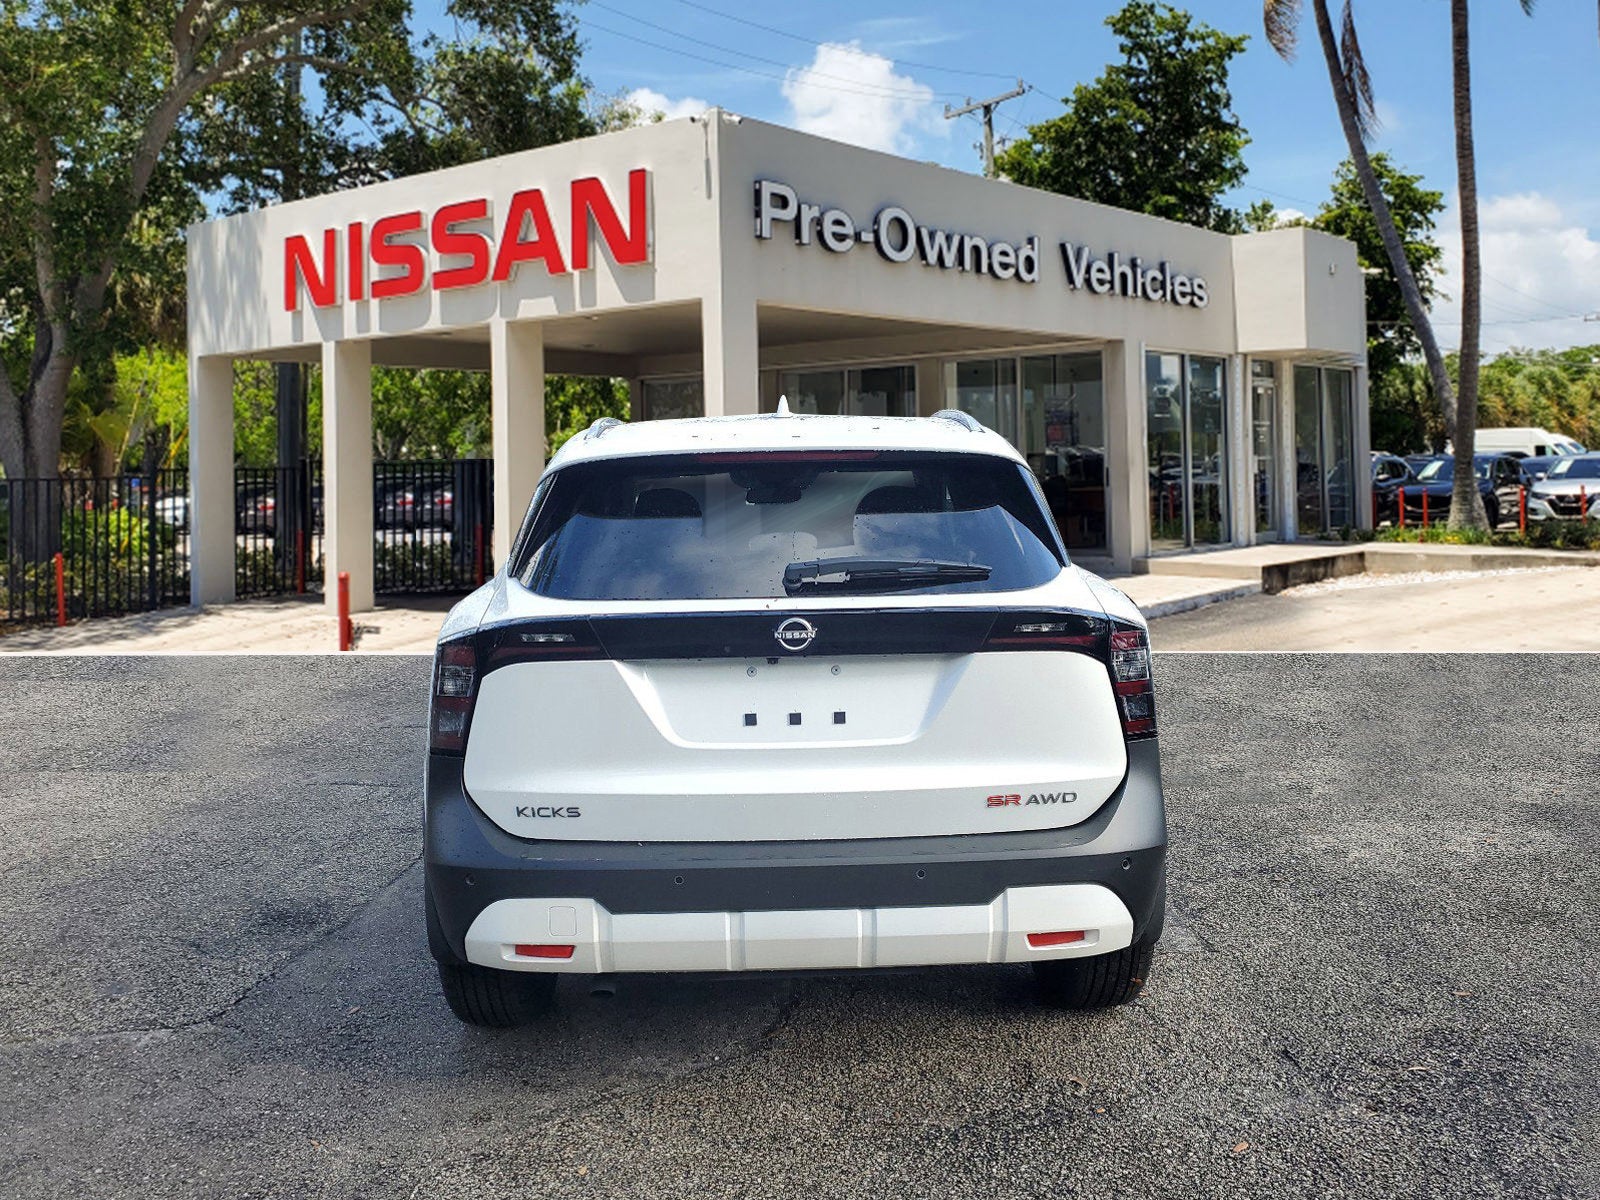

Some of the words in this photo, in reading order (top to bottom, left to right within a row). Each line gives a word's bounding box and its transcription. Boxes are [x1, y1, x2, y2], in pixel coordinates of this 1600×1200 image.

[285, 168, 647, 311] NISSAN
[755, 180, 1039, 283] Pre-Owned
[1060, 242, 1208, 308] Vehicles
[774, 631, 816, 639] NISSAN
[987, 794, 1021, 808] SR
[1025, 792, 1077, 806] AWD
[516, 806, 581, 818] KICKS
